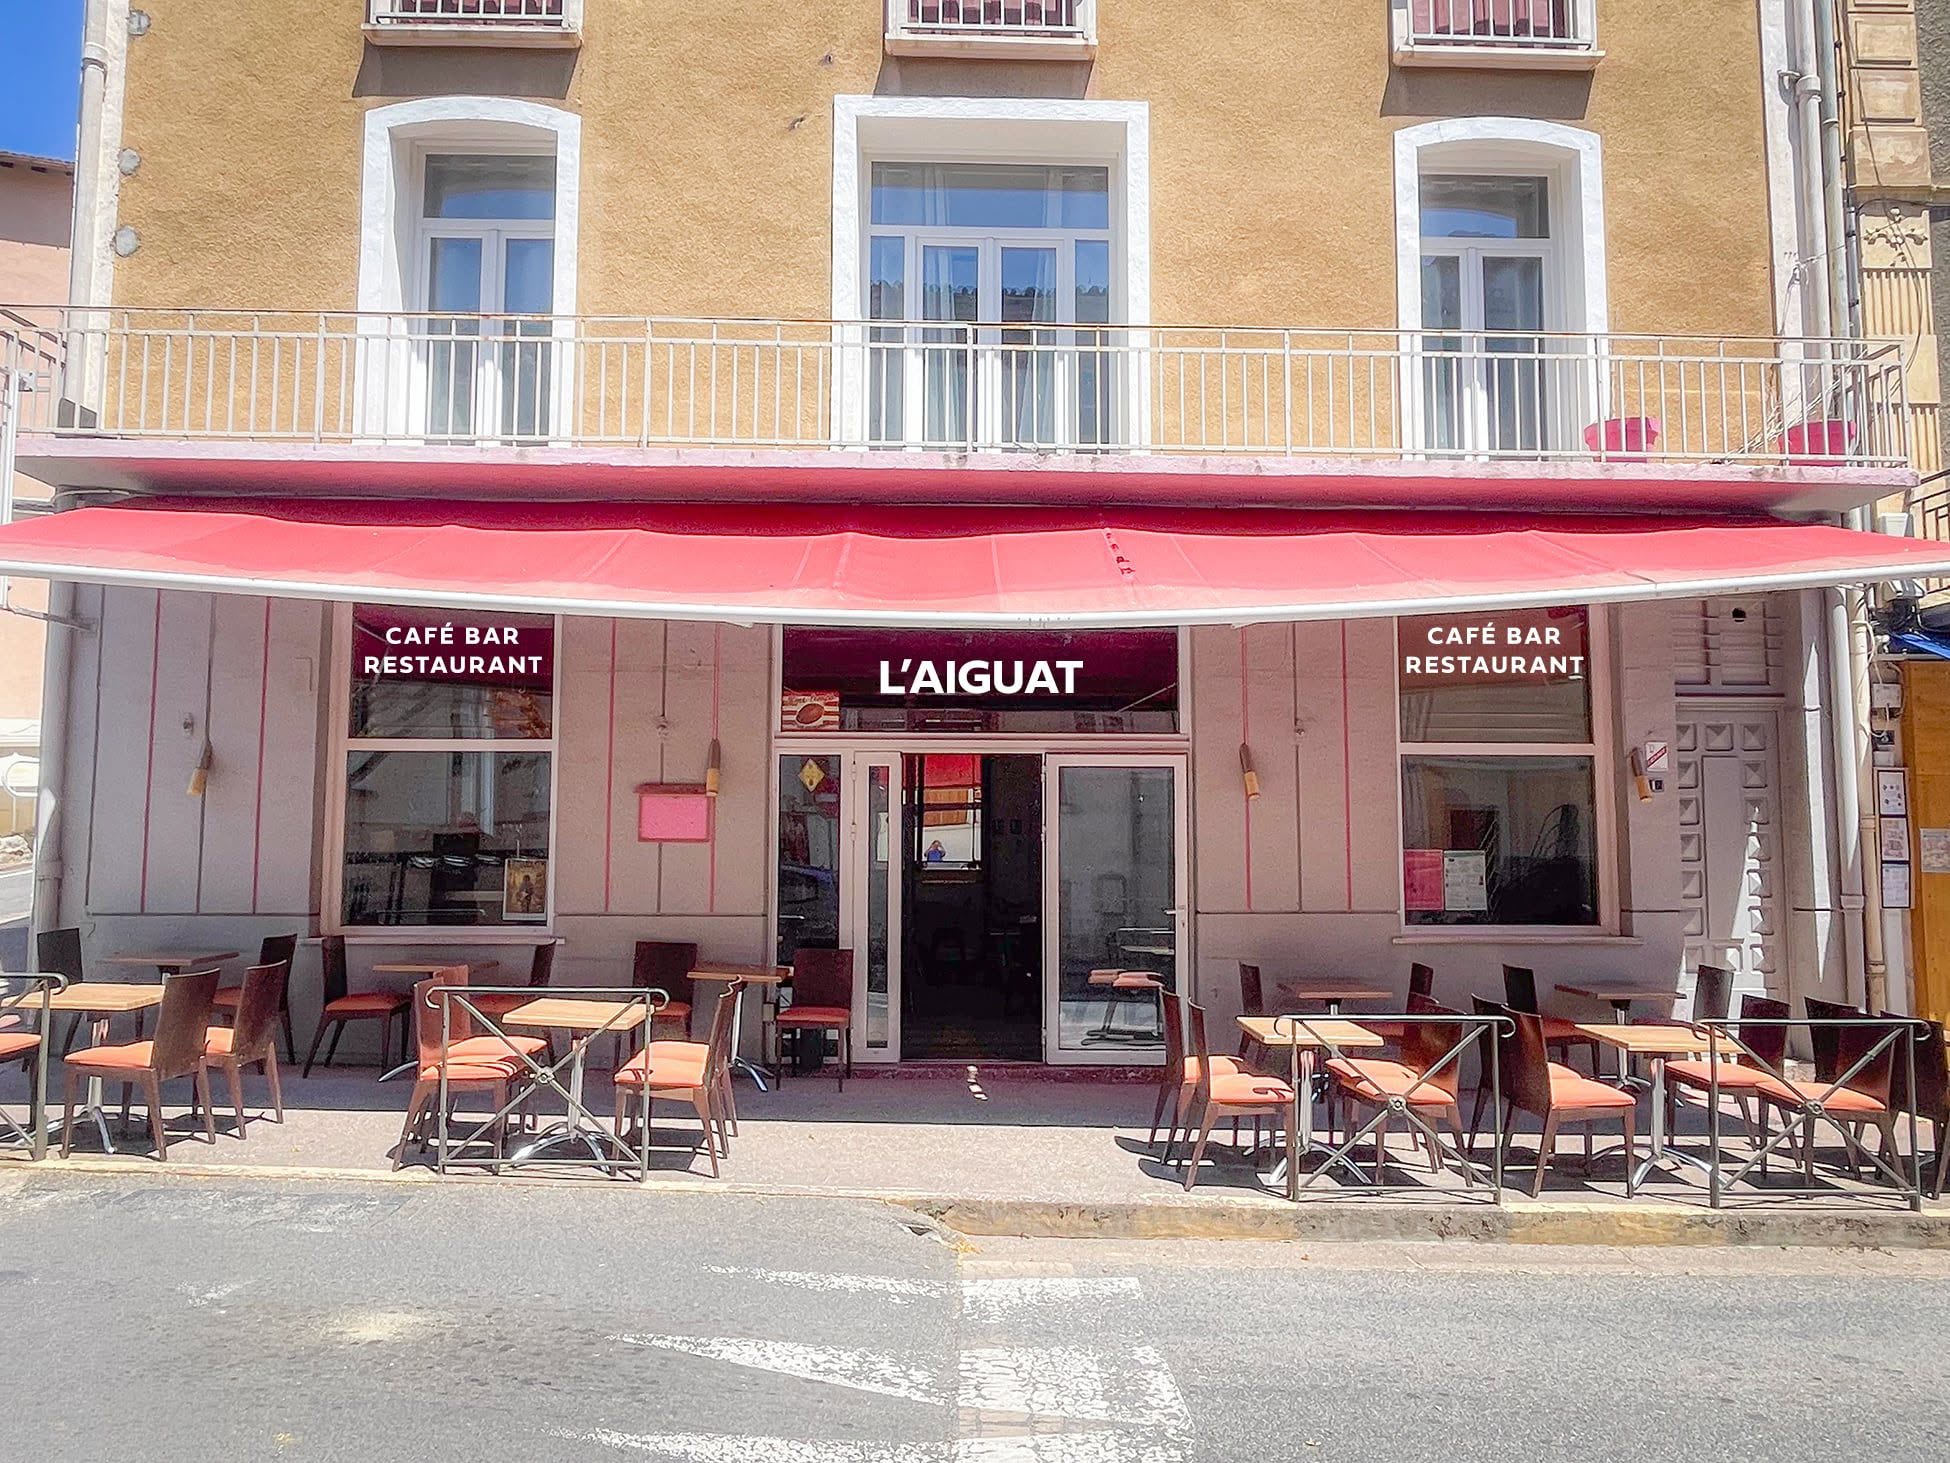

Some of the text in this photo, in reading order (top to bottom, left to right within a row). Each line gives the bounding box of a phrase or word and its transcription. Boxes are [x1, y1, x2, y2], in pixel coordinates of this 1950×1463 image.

[385, 622, 519, 645] CAFÉ BAR
[1427, 622, 1561, 645] CAFÉ BAR
[364, 656, 543, 674] RESTAURANT
[1406, 656, 1585, 674] RESTAURANT
